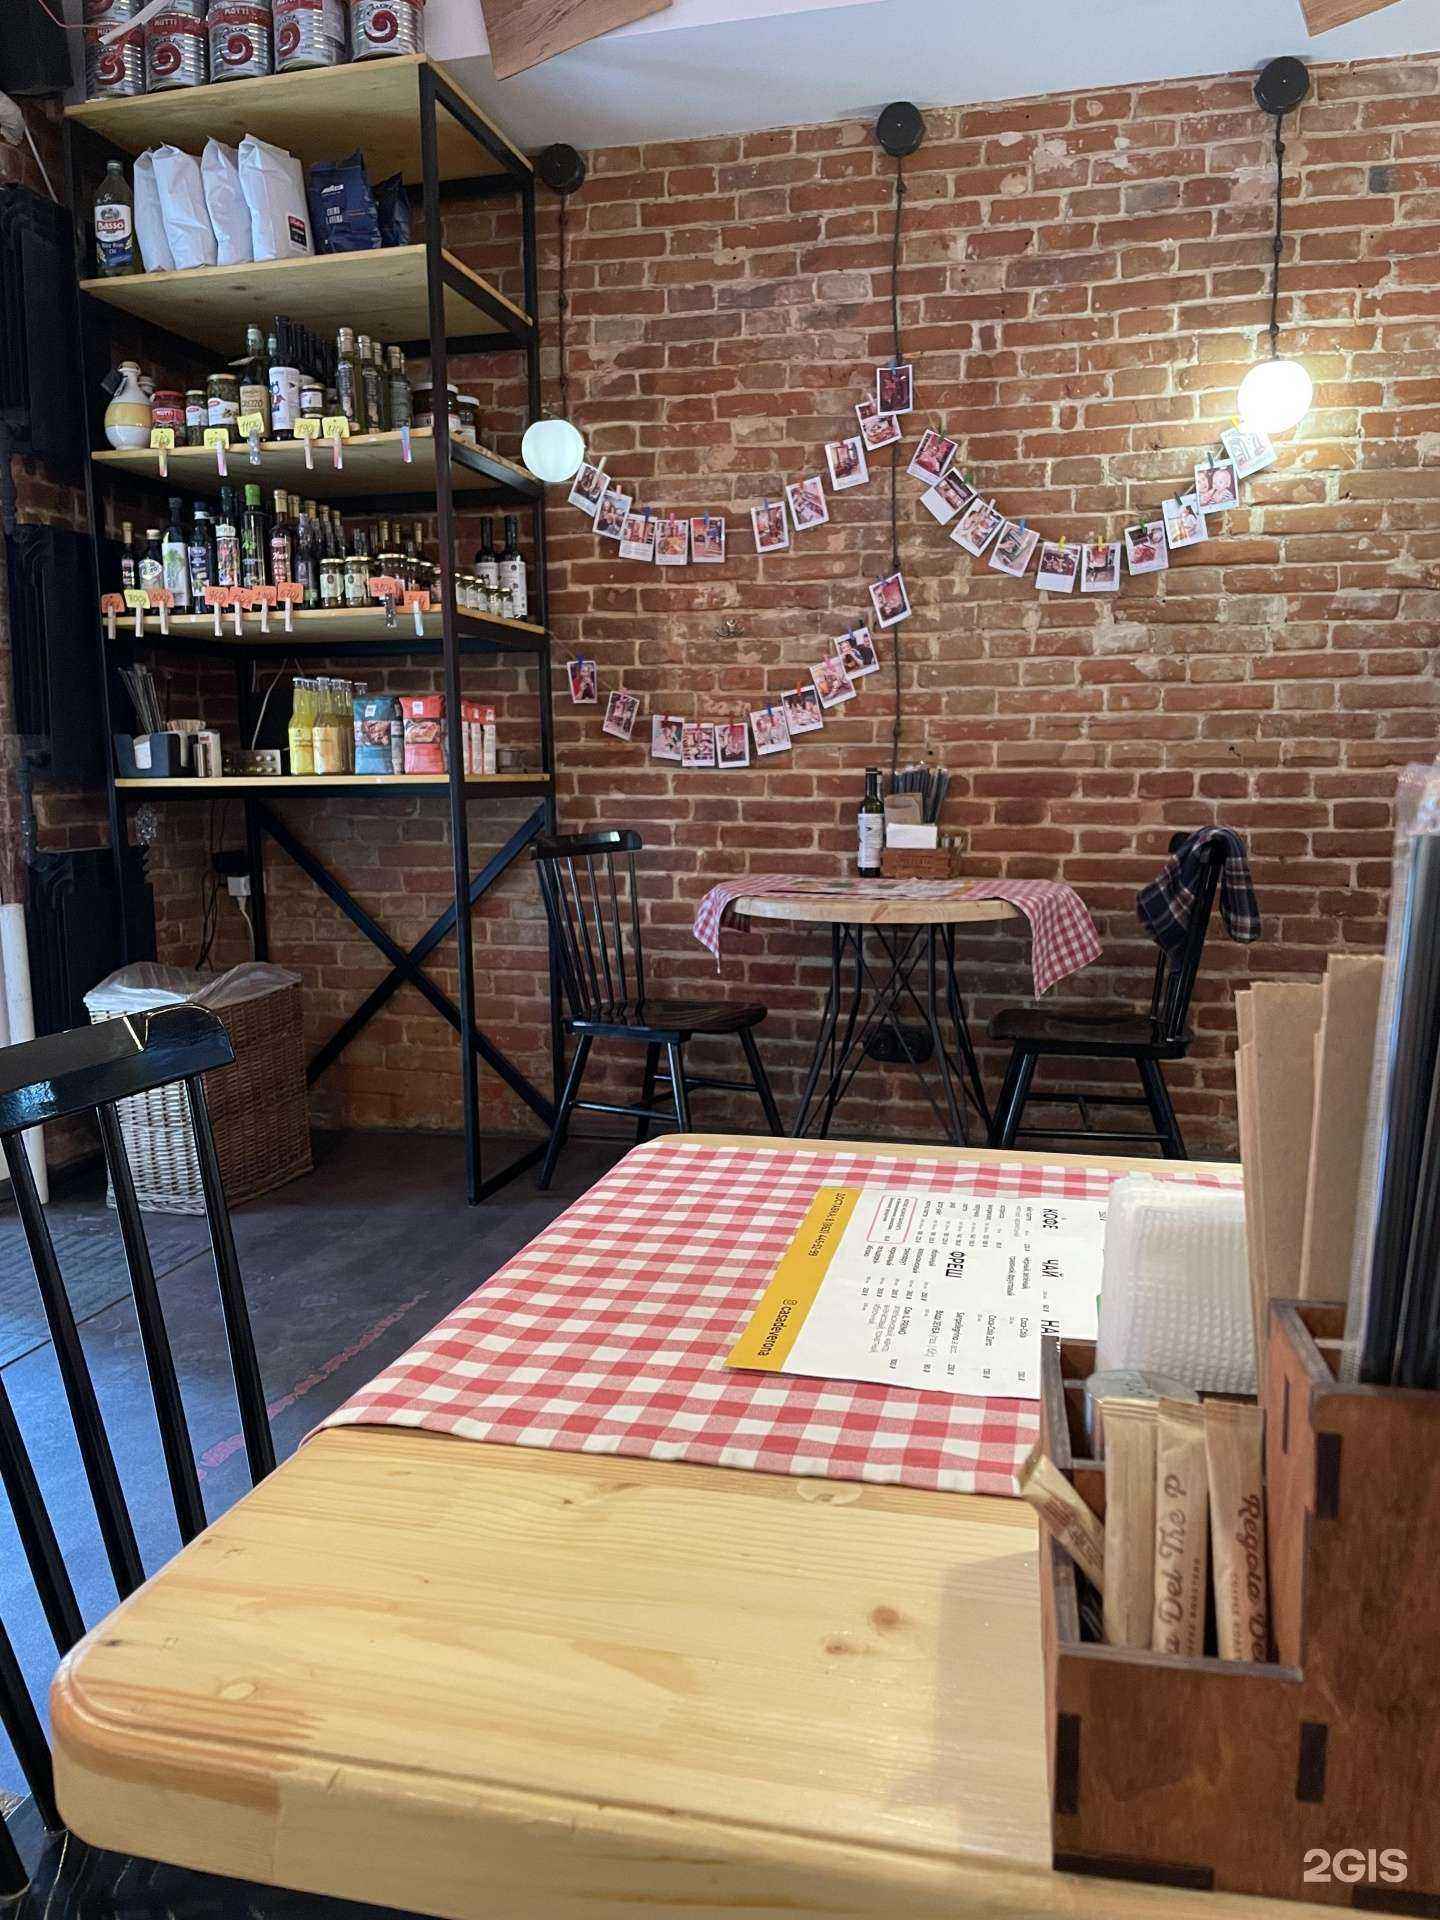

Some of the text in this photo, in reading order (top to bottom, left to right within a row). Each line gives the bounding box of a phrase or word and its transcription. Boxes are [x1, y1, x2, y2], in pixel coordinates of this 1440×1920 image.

[1043, 1208, 1059, 1230] КОФЕ
[946, 1251, 966, 1279] ФРЕШ
[1042, 1260, 1063, 1278] ЧАЙ
